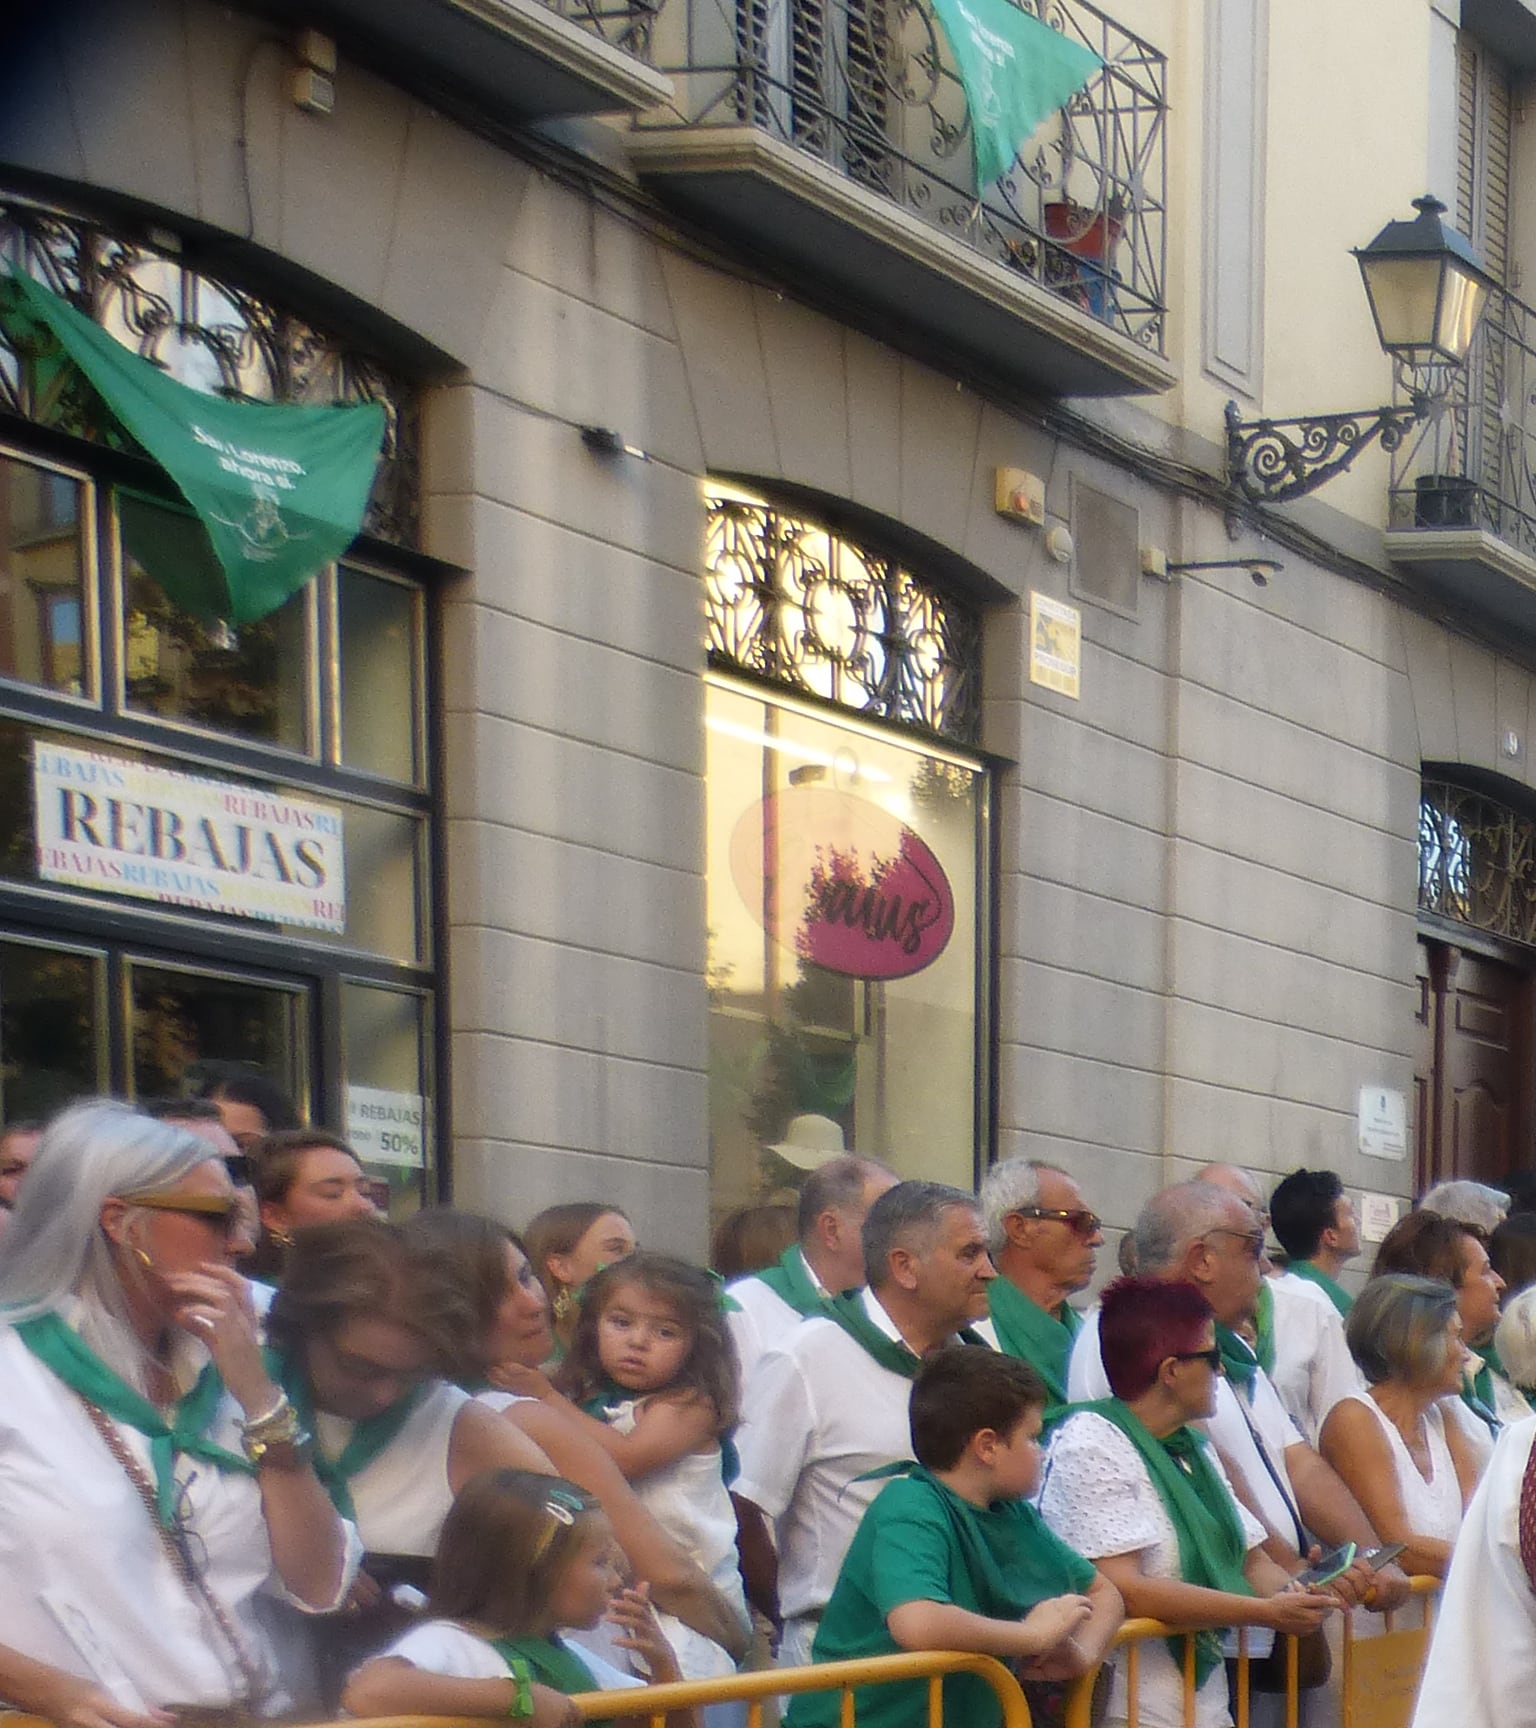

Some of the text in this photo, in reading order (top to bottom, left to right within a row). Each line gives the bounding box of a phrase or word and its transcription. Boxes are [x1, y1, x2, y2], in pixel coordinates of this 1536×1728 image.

[57, 786, 328, 890] REBAJAS
[360, 1103, 420, 1126] REBAJAS
[381, 1131, 419, 1155] 50%
